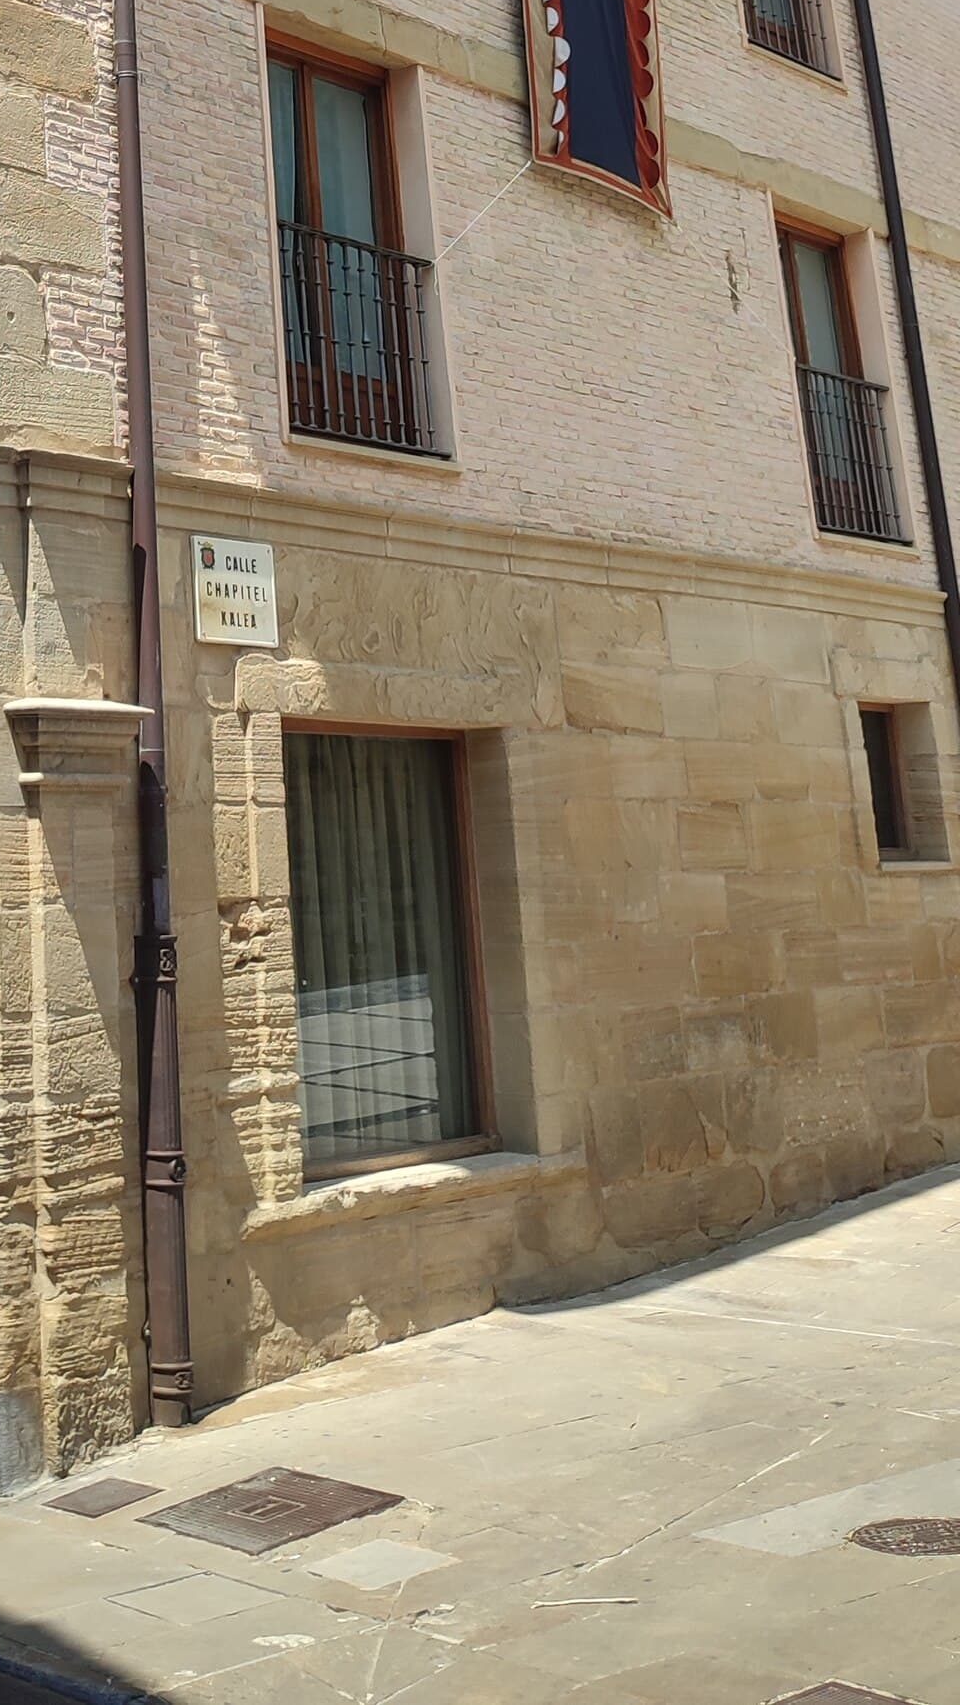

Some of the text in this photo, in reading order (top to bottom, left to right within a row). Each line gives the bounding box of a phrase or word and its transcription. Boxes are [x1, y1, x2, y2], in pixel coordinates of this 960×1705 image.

[225, 555, 257, 574] CALLE
[206, 581, 268, 603] CHAPITEL
[221, 611, 257, 629] KALEA
